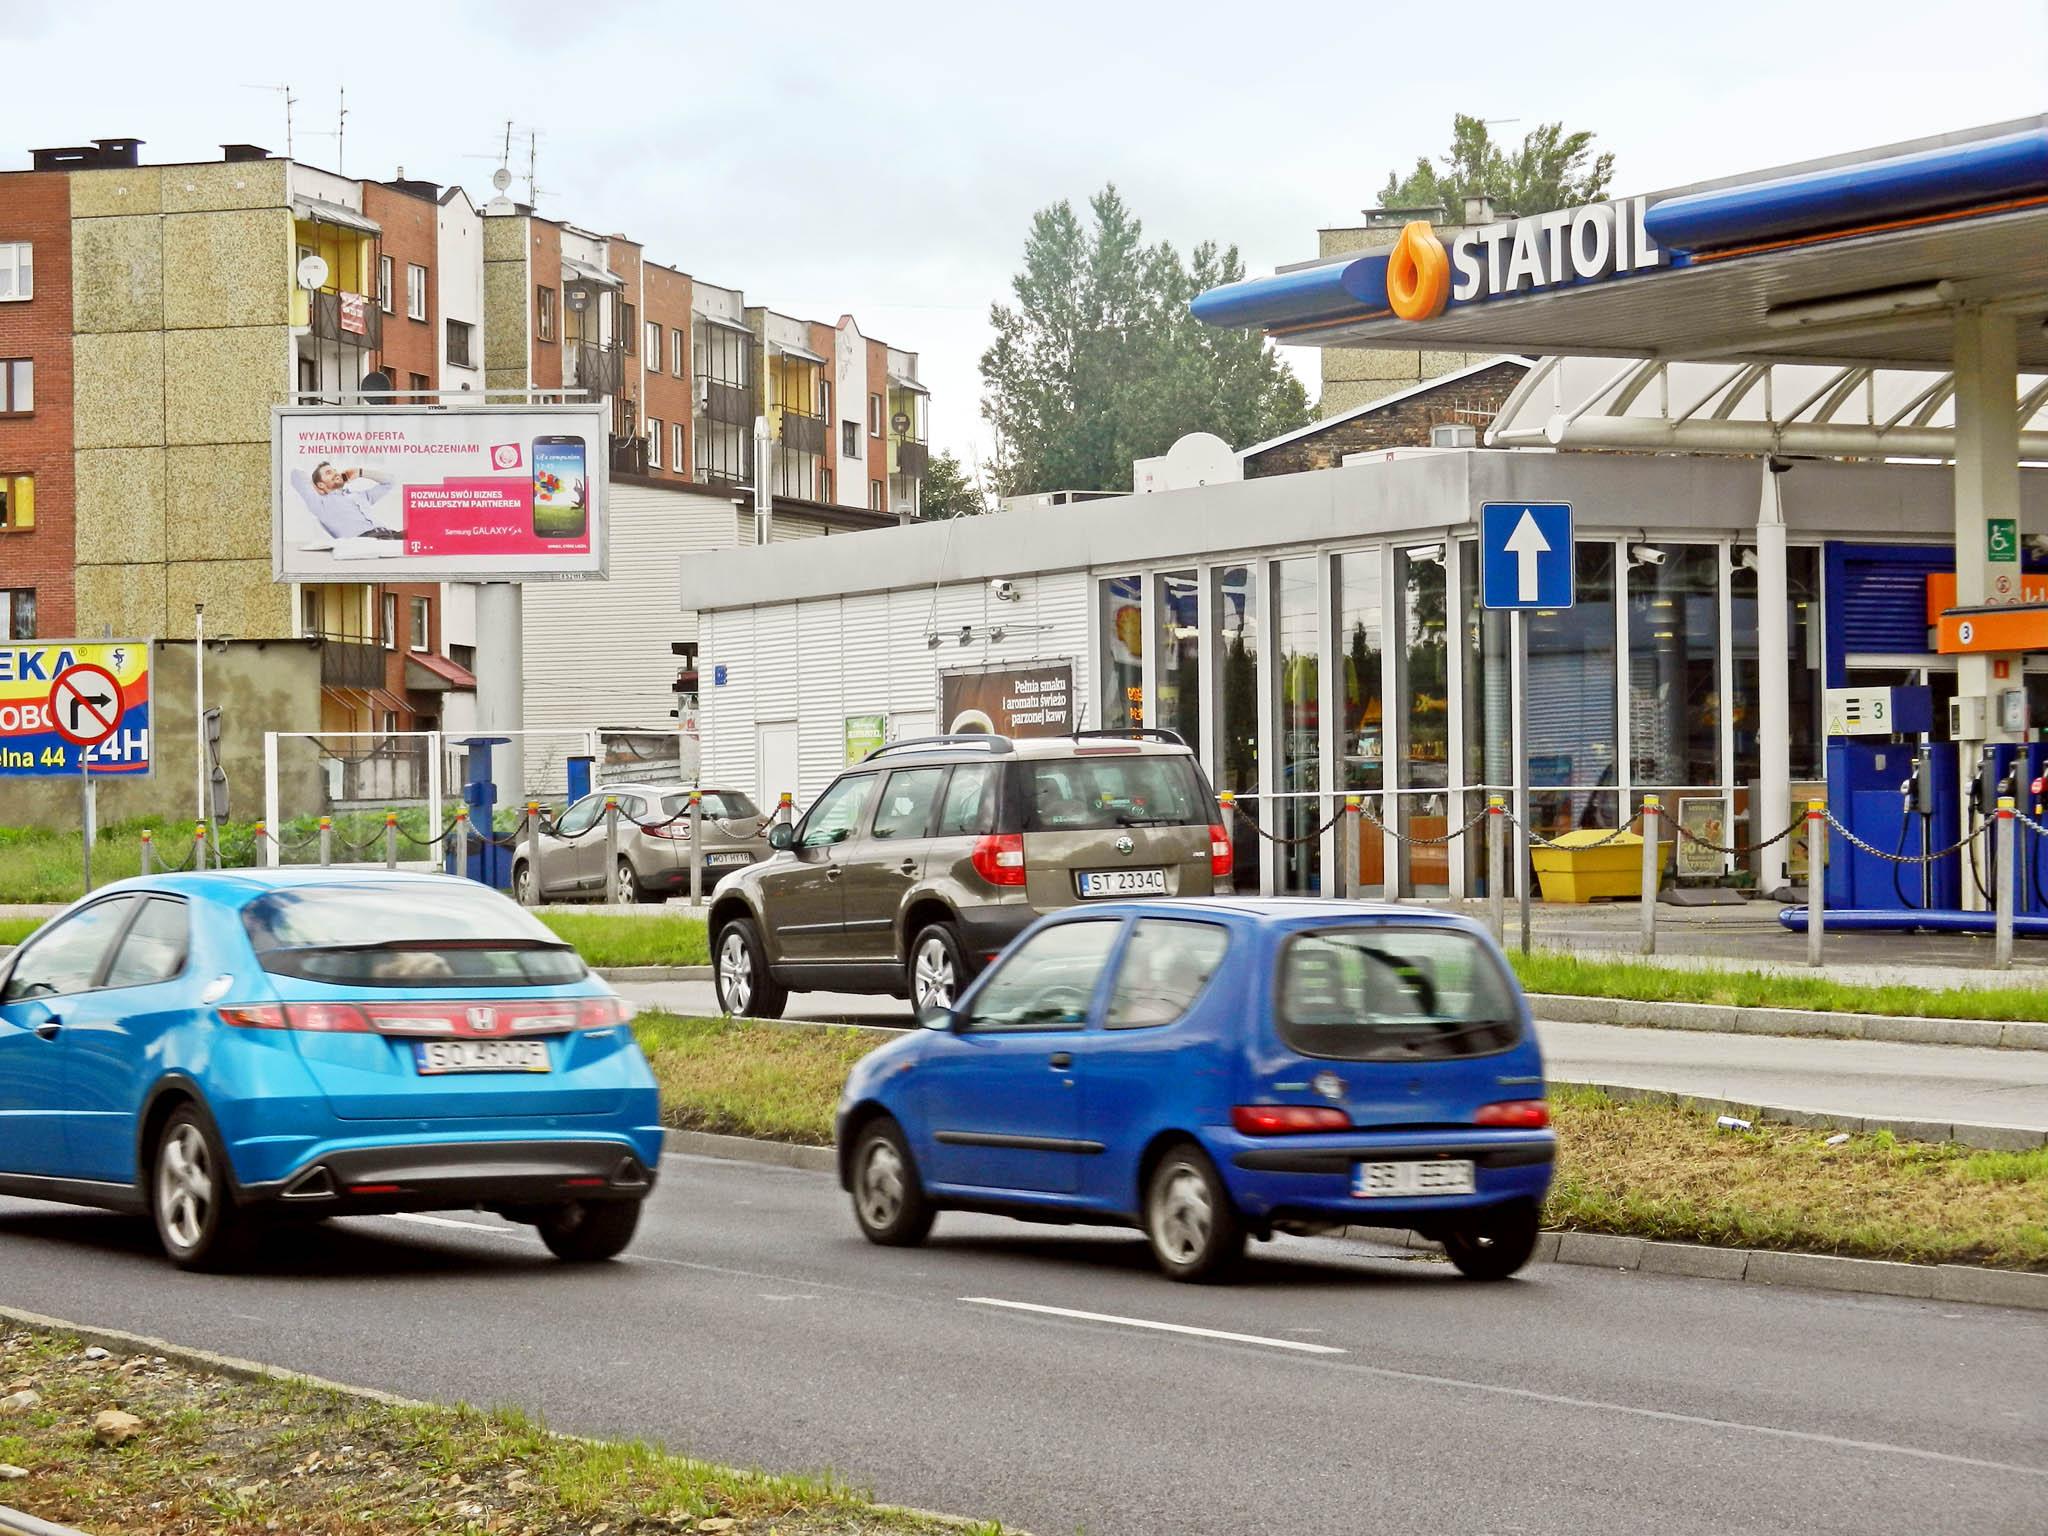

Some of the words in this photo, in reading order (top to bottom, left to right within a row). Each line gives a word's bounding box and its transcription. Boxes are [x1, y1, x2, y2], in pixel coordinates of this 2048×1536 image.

[1452, 195, 1659, 301] STATOIL
[299, 431, 362, 443] WYJĄTKOWA
[365, 431, 405, 441] OFERTA
[299, 445, 306, 455] Z
[308, 445, 401, 454] NIELIMITOWANYMI
[403, 444, 480, 456] POŁĄCZENIAMI
[411, 491, 449, 499] ROZWIJAJ
[450, 490, 473, 499] SWÓJ
[474, 491, 502, 499] BIZNES
[418, 500, 470, 508] NAJLEPSZYM
[471, 500, 521, 508] PARTNEREM
[445, 528, 472, 537] Samsung
[473, 526, 507, 535] GALAXY
[1963, 625, 1970, 640] 3
[1014, 679, 1040, 694] Pełnia
[1040, 677, 1066, 692] smaku
[1006, 695, 1039, 710] aromatu
[1040, 692, 1067, 707] świeżo
[1011, 709, 1044, 727] parzonej
[1045, 708, 1067, 724] kawy
[1873, 702, 1884, 720] 3
[0, 747, 35, 768] lna
[40, 746, 66, 767] 44
[1091, 874, 1111, 890] ST
[1118, 872, 1163, 889] 2334C
